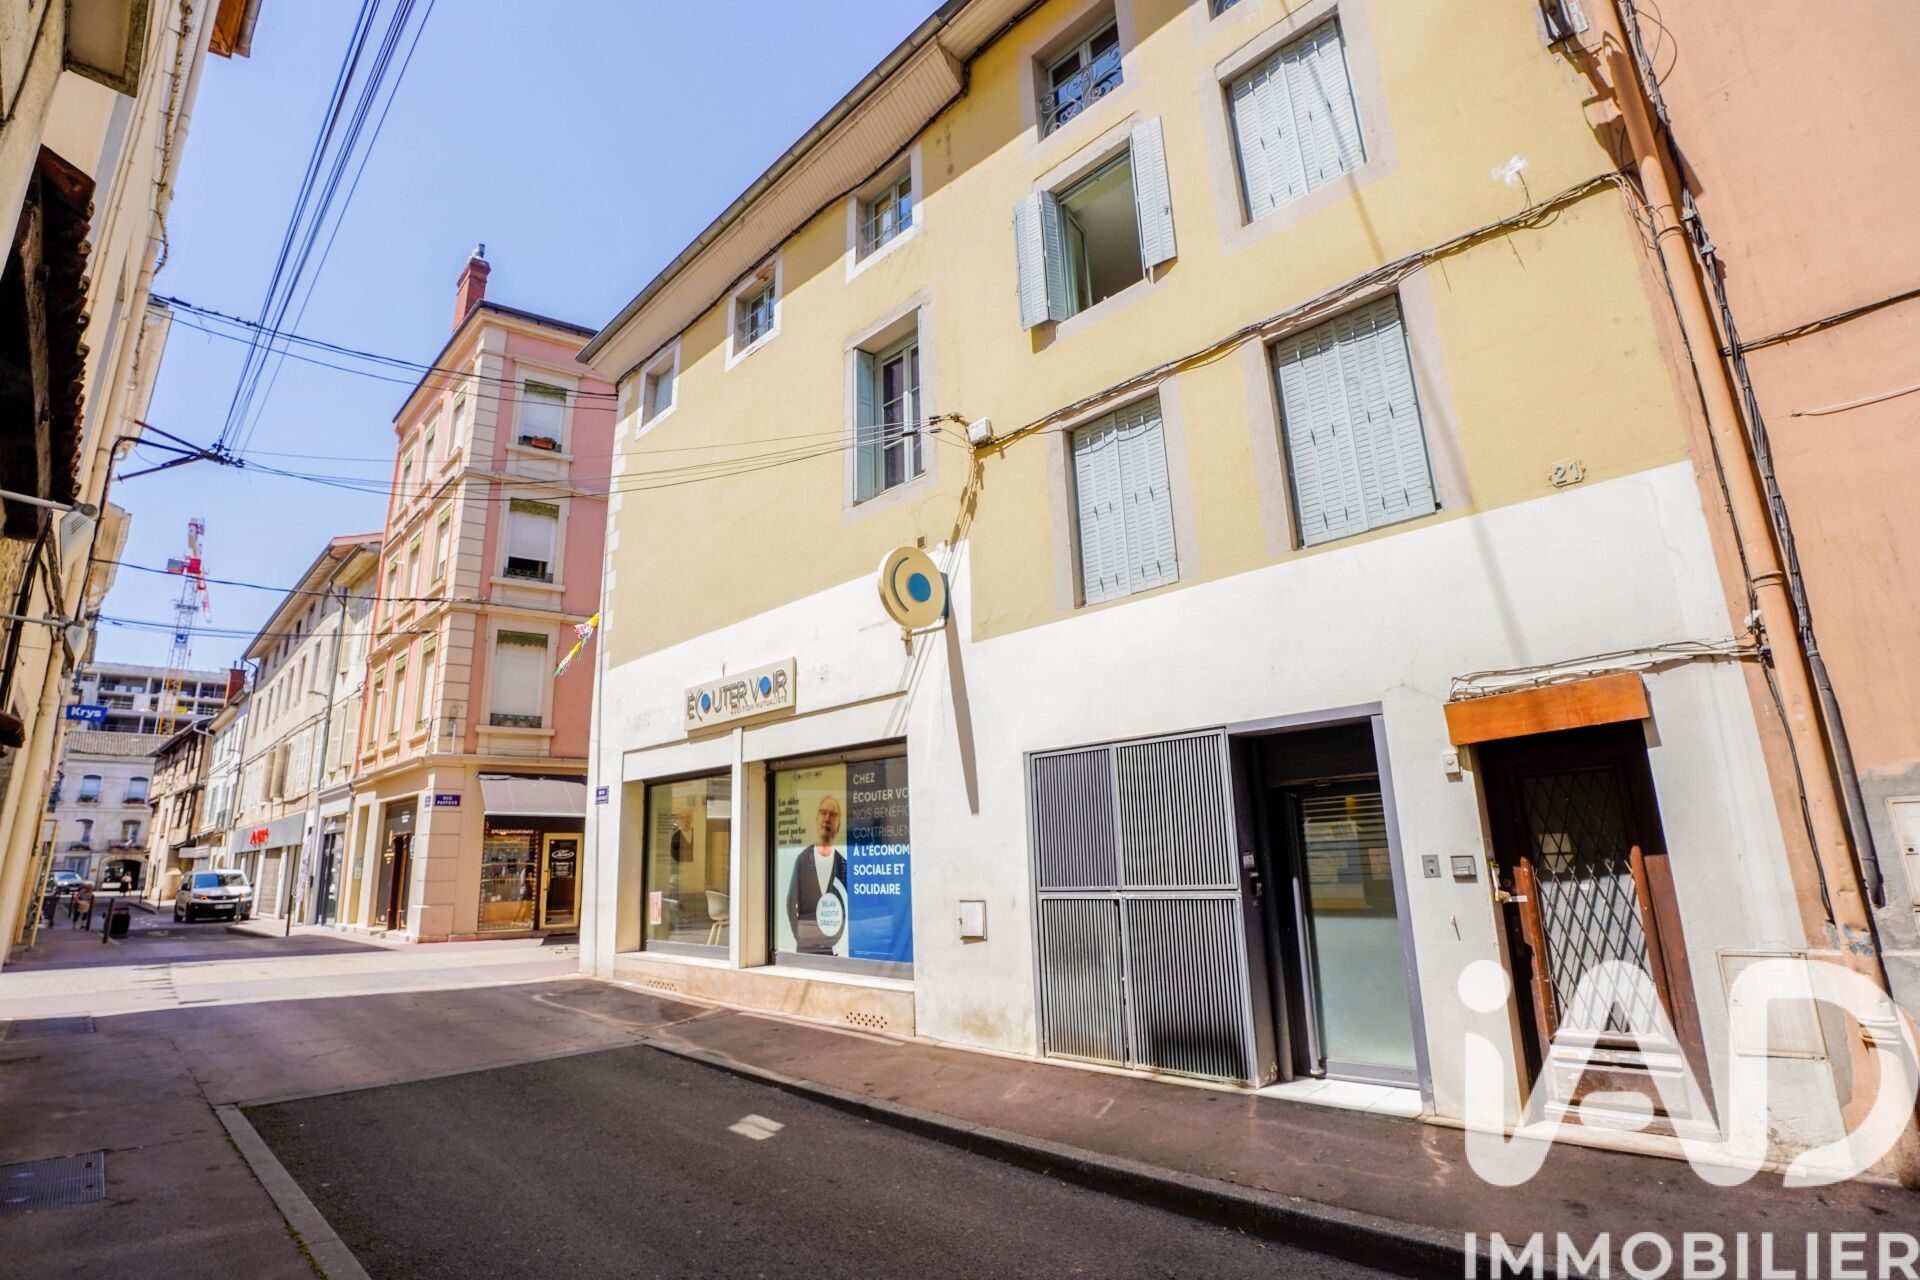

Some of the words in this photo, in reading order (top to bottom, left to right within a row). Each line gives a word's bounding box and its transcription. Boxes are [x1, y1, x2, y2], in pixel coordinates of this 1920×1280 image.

[1552, 460, 1580, 485] 21
[687, 681, 748, 722] ÉCOUTER
[749, 669, 788, 703] VOIR
[71, 706, 101, 719] Krys
[853, 772, 876, 785] CHEZ
[853, 788, 894, 803] ÉCOUTER
[853, 808, 873, 820] NOS
[853, 843, 859, 857] À
[853, 864, 892, 876] SOCIALE
[893, 863, 905, 875] ET
[853, 883, 901, 895] SOLIDAIRE
